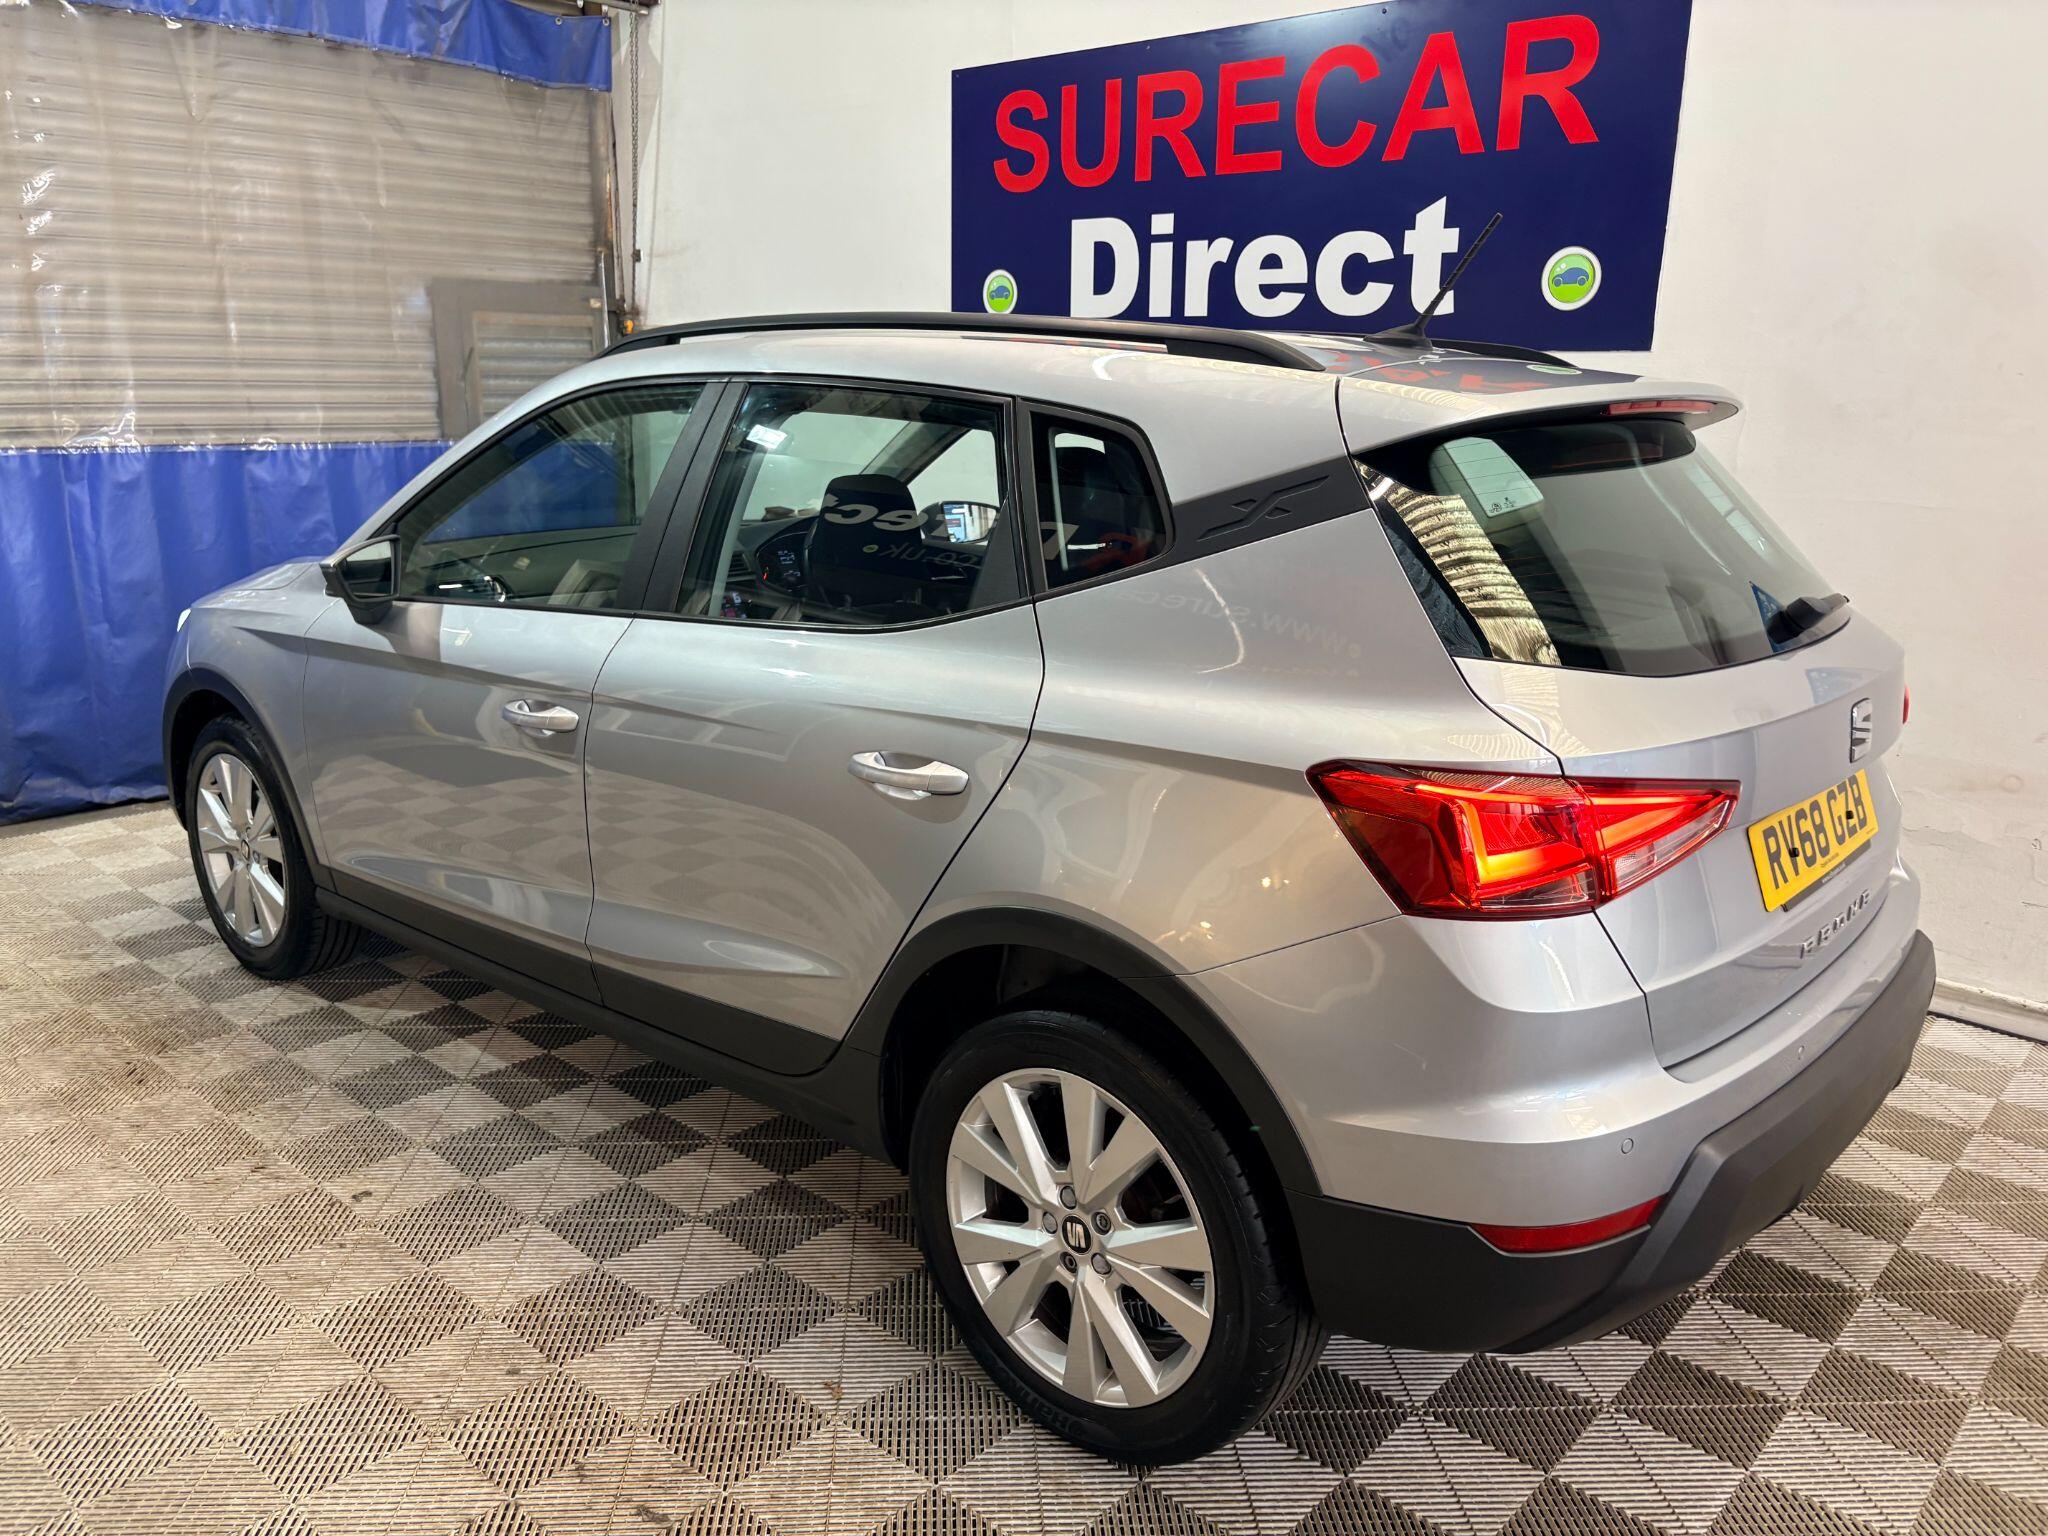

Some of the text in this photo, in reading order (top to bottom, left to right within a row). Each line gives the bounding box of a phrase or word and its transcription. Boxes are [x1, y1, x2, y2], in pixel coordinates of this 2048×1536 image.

[993, 14, 1601, 193] SURECAR
[1070, 196, 1459, 318] Direct
[1762, 774, 1869, 890] RV68 GZB
